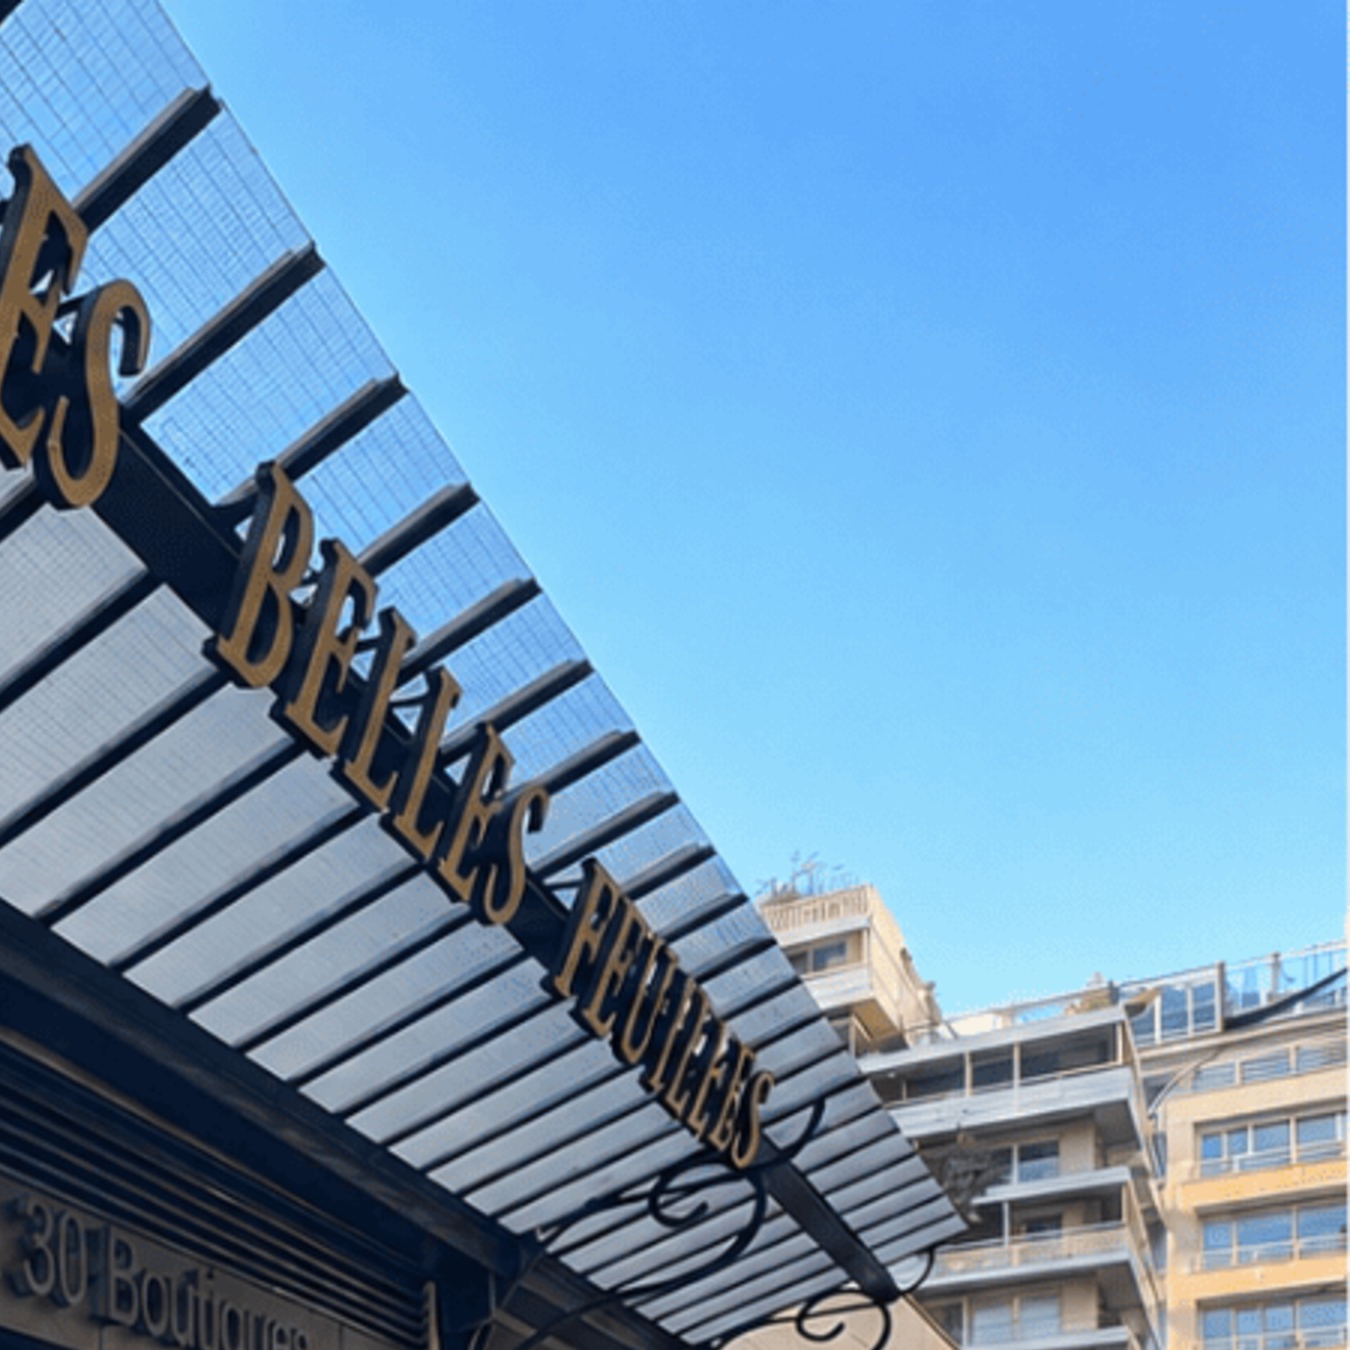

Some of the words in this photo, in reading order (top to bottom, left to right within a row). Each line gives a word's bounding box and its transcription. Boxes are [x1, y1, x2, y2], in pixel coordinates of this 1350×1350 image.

[212, 460, 548, 924] BELLES
[550, 858, 775, 1170] FEUILLES
[22, 1200, 88, 1306] 30
